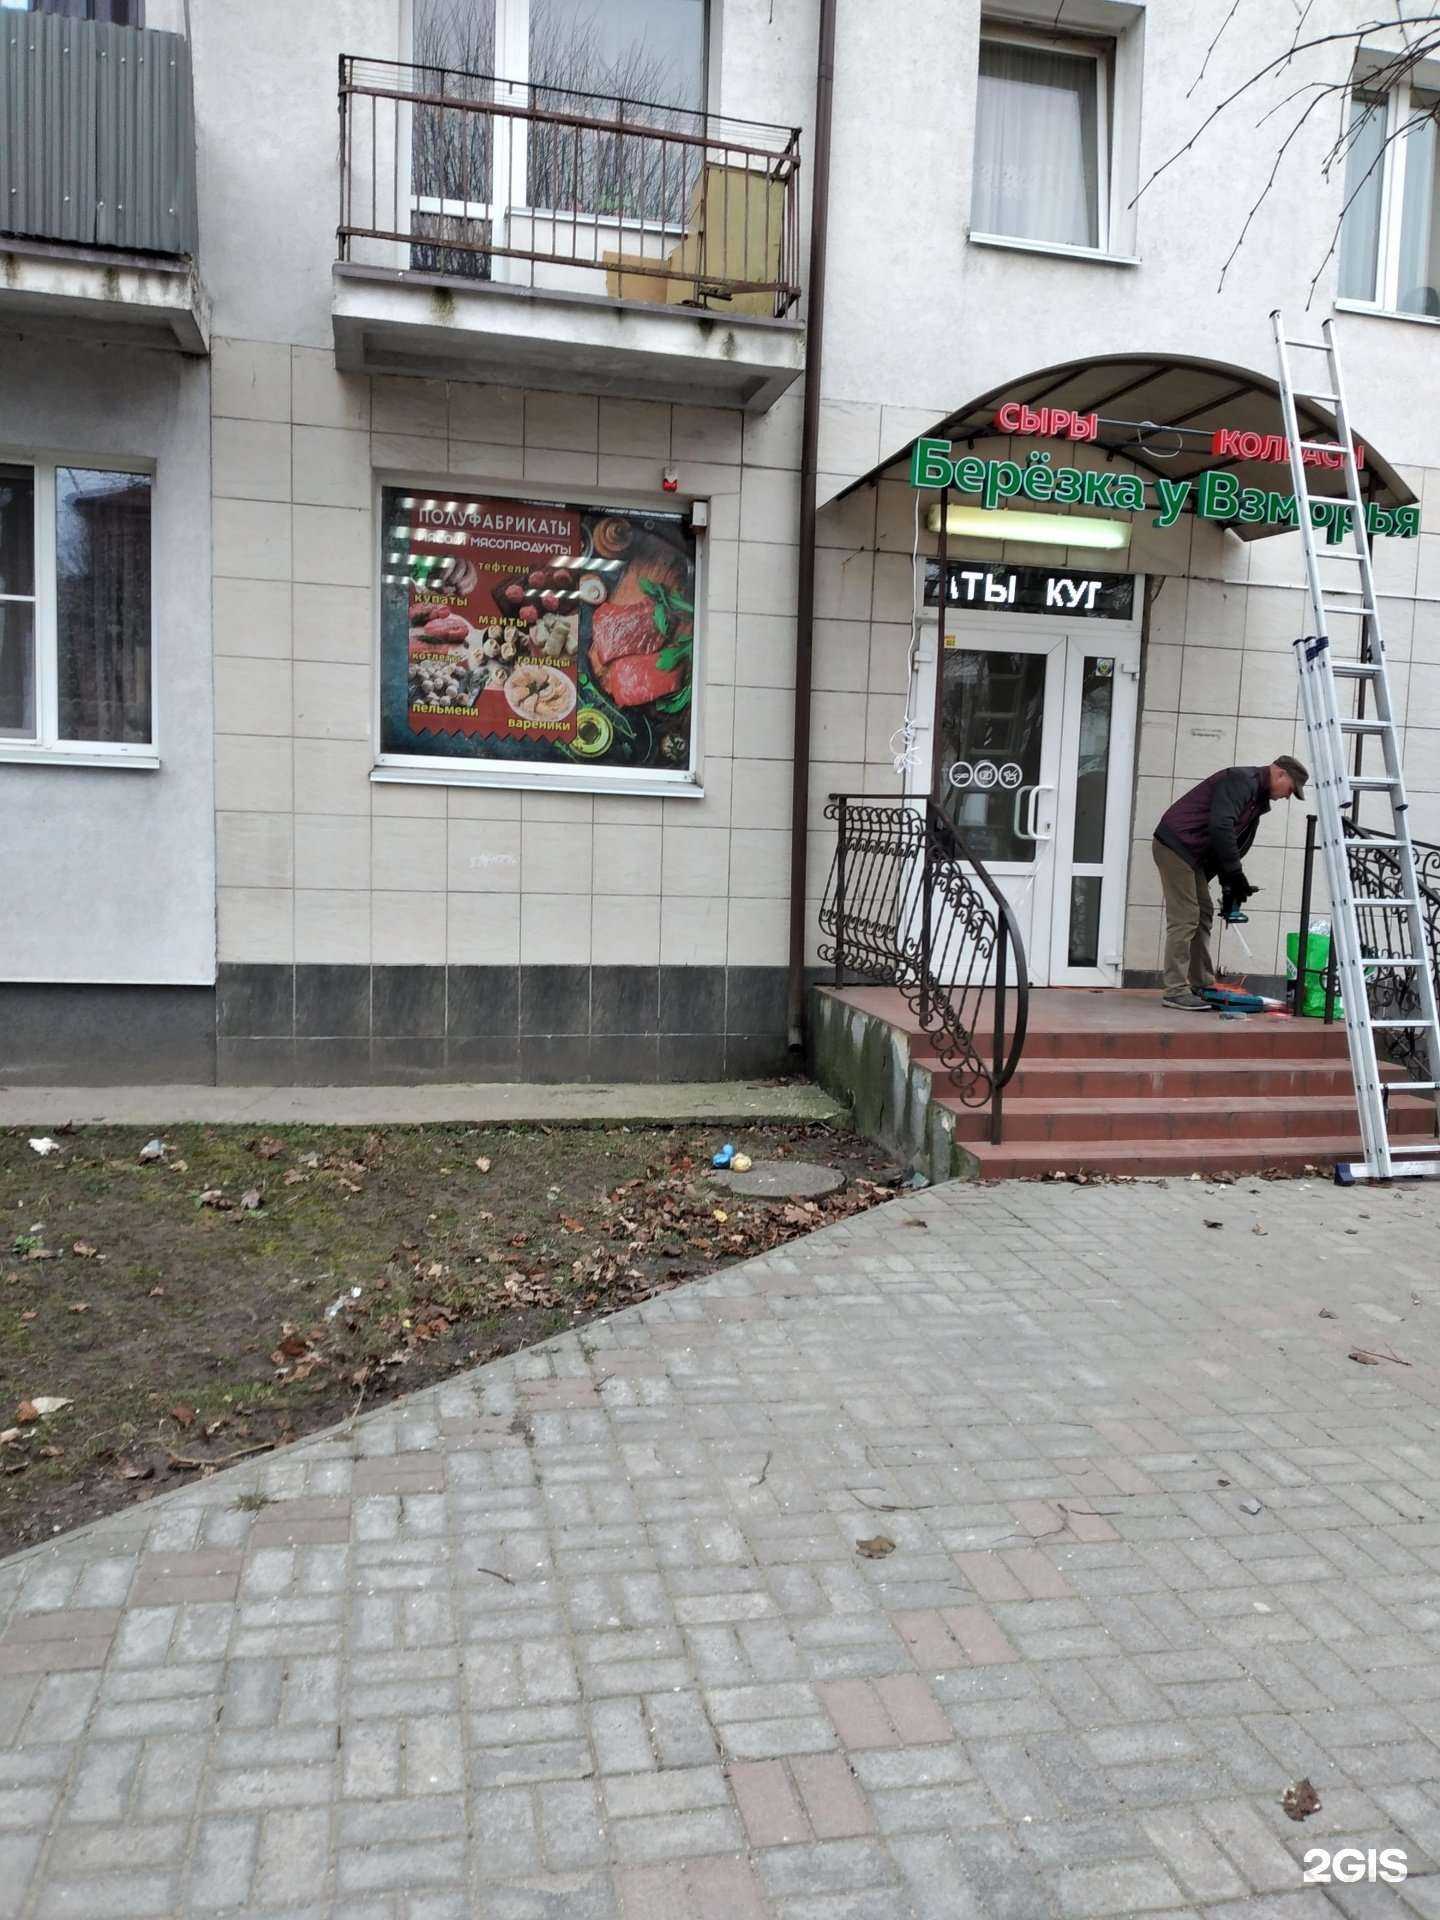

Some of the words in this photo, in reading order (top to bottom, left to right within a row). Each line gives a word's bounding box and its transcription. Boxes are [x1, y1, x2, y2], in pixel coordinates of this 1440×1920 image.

[998, 402, 1098, 441] СЫРЫ
[912, 437, 1146, 510] Берёзка
[1155, 478, 1192, 527] у
[1201, 470, 1420, 544] Взморья
[419, 508, 571, 537] ПОЛУФАБРИКАТЫ
[470, 537, 572, 555] МЯСОПРОДУКТЫ
[478, 561, 530, 574] тефтели
[414, 594, 468, 608] купаты
[478, 615, 527, 628] манты
[516, 655, 570, 668] голубцы
[412, 703, 479, 717] пельмени
[508, 718, 571, 731] вареники
